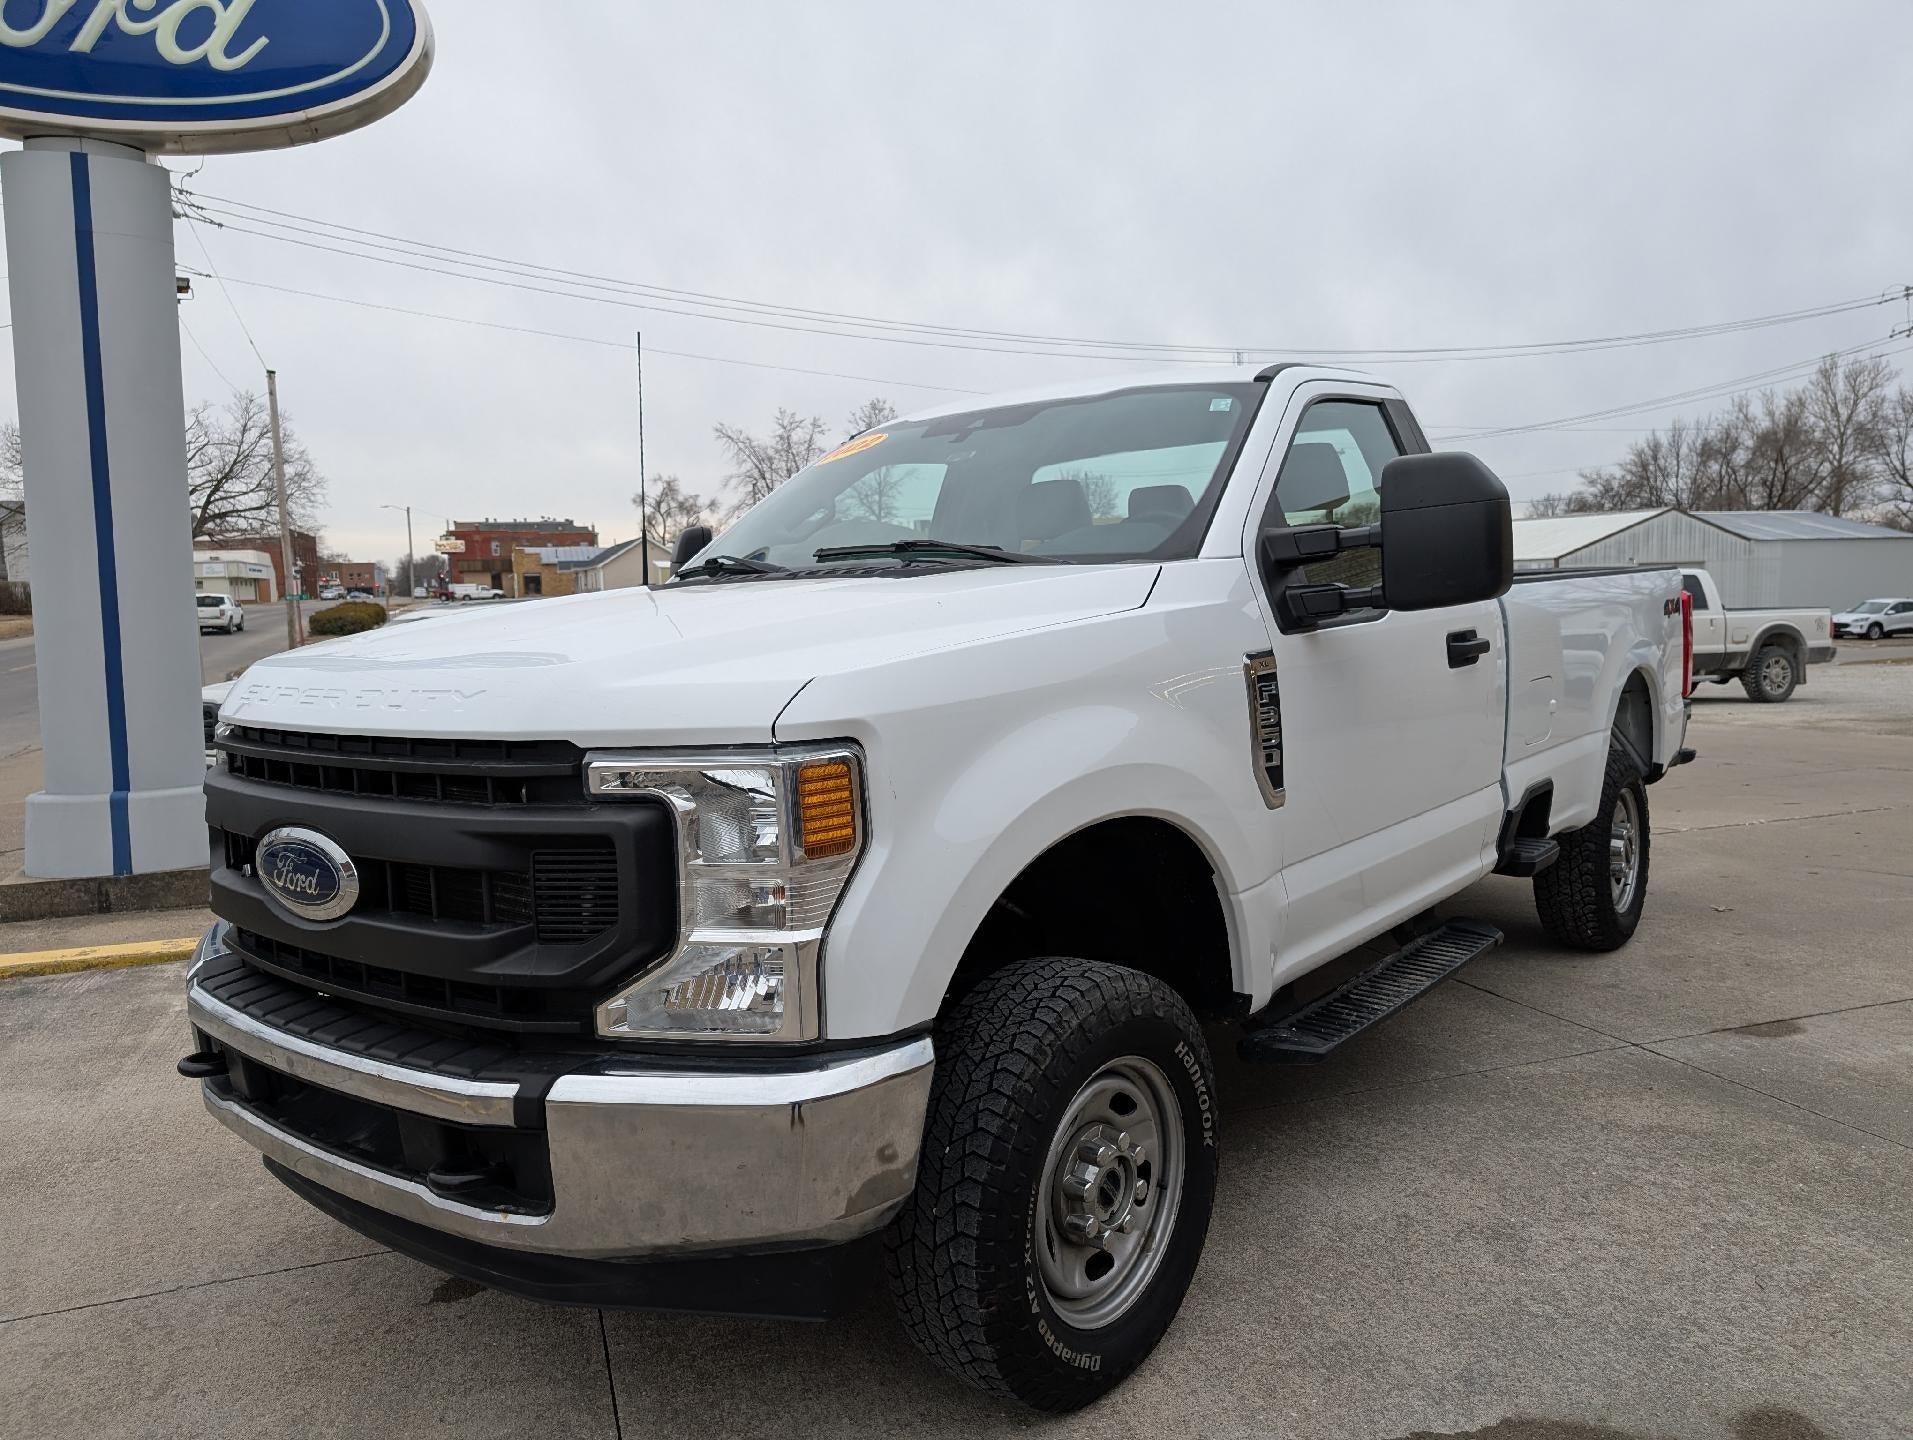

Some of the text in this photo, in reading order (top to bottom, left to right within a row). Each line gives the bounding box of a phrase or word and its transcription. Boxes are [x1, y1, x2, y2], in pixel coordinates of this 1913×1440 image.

[0, 0, 270, 71] ord
[1258, 661, 1270, 669] XL
[238, 684, 488, 712] SUPER DUTY
[273, 852, 320, 895] Ford
[1026, 1273, 1040, 1314] AT2
